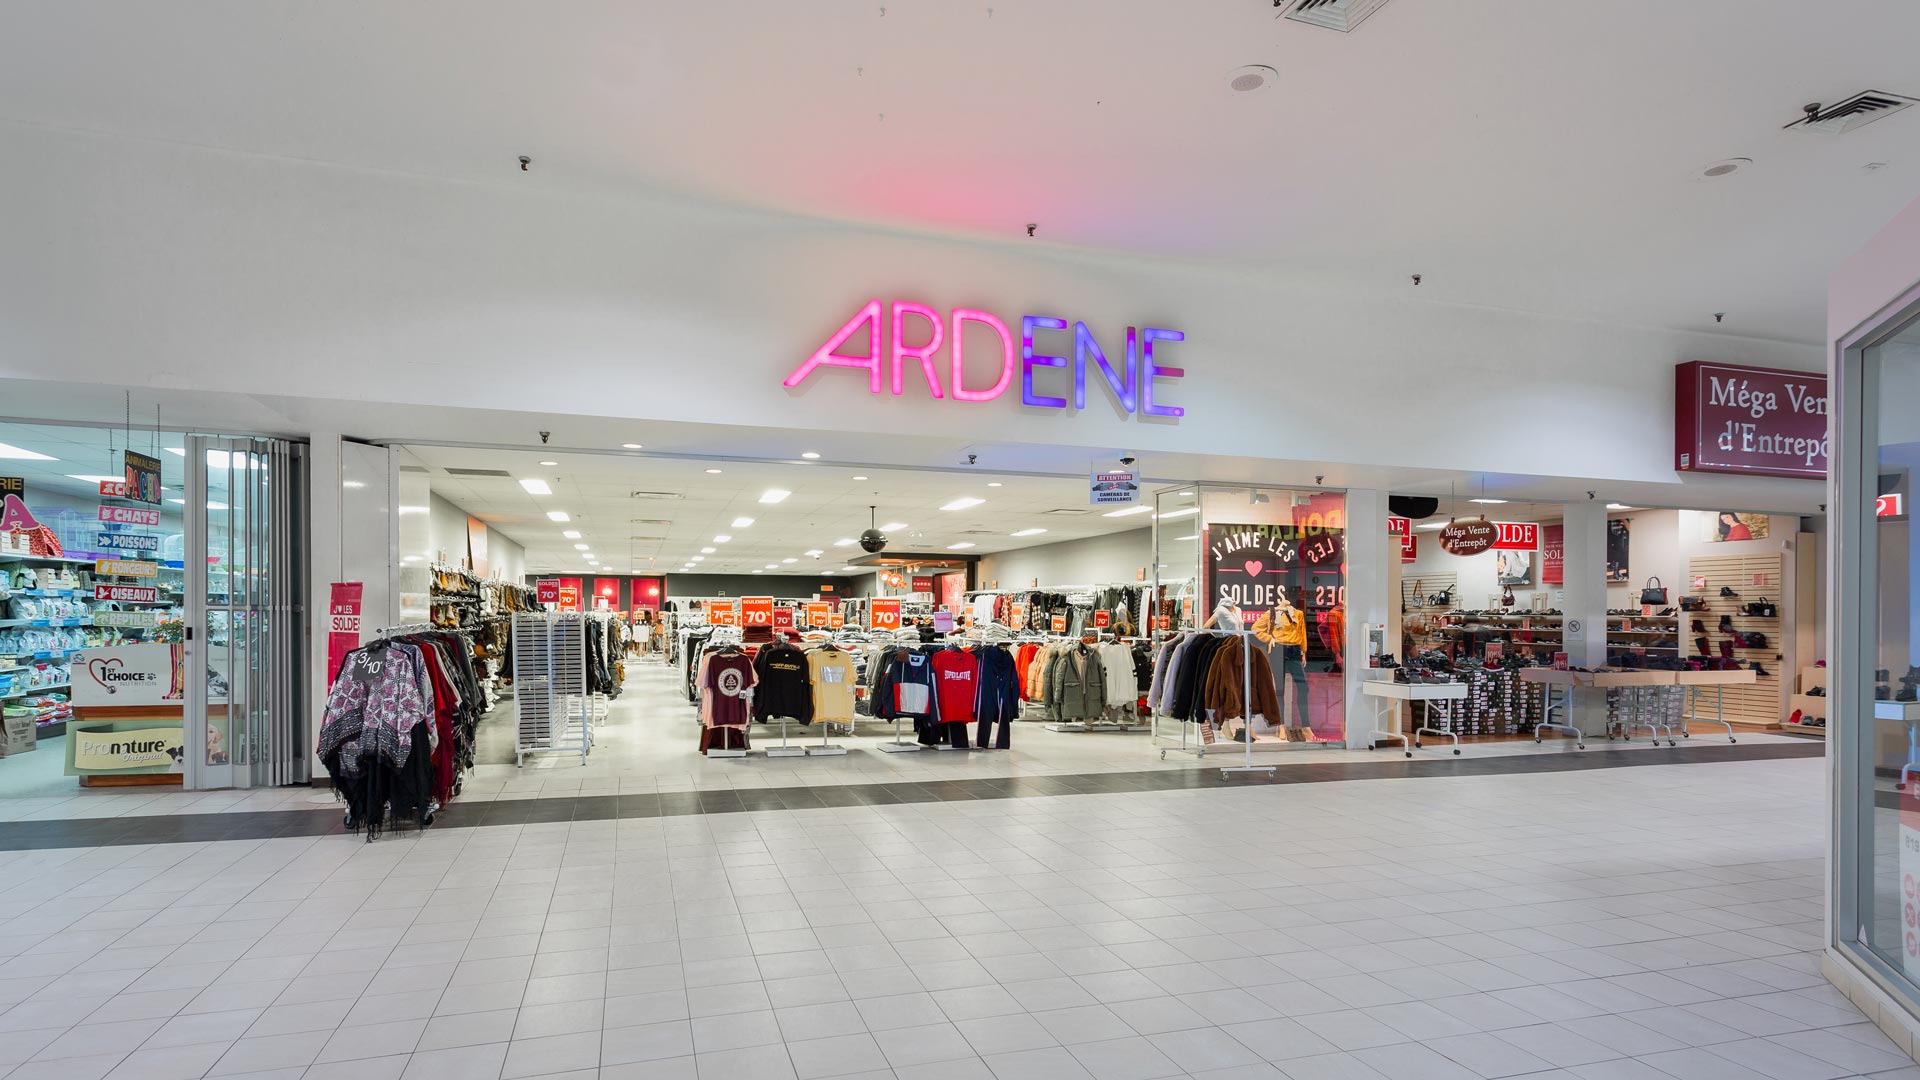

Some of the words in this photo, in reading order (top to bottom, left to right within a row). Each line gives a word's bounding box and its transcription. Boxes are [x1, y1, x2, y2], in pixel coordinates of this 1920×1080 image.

[783, 299, 1185, 417] ARDENE
[1709, 376, 1778, 418] Méga
[125, 454, 161, 472] ANIMALERIE
[125, 465, 161, 503] PACHA
[114, 508, 158, 524] CHATS
[1445, 528, 1466, 538] Méga
[1468, 525, 1490, 534] Vente
[112, 536, 157, 550] POISSONS
[1212, 531, 1260, 561] J'AIME
[1268, 536, 1295, 562] LES
[1448, 537, 1487, 549] d'Entrepôt
[112, 561, 156, 575] RONGEURS
[111, 587, 154, 601] OISEAUX
[1220, 584, 1286, 606] SOLDES
[343, 605, 353, 615] LES
[109, 612, 153, 625] REPTILES
[873, 611, 899, 624] -70%
[107, 673, 145, 681] CHOICE
[81, 740, 165, 756] Pronature
[123, 753, 164, 763] Original
